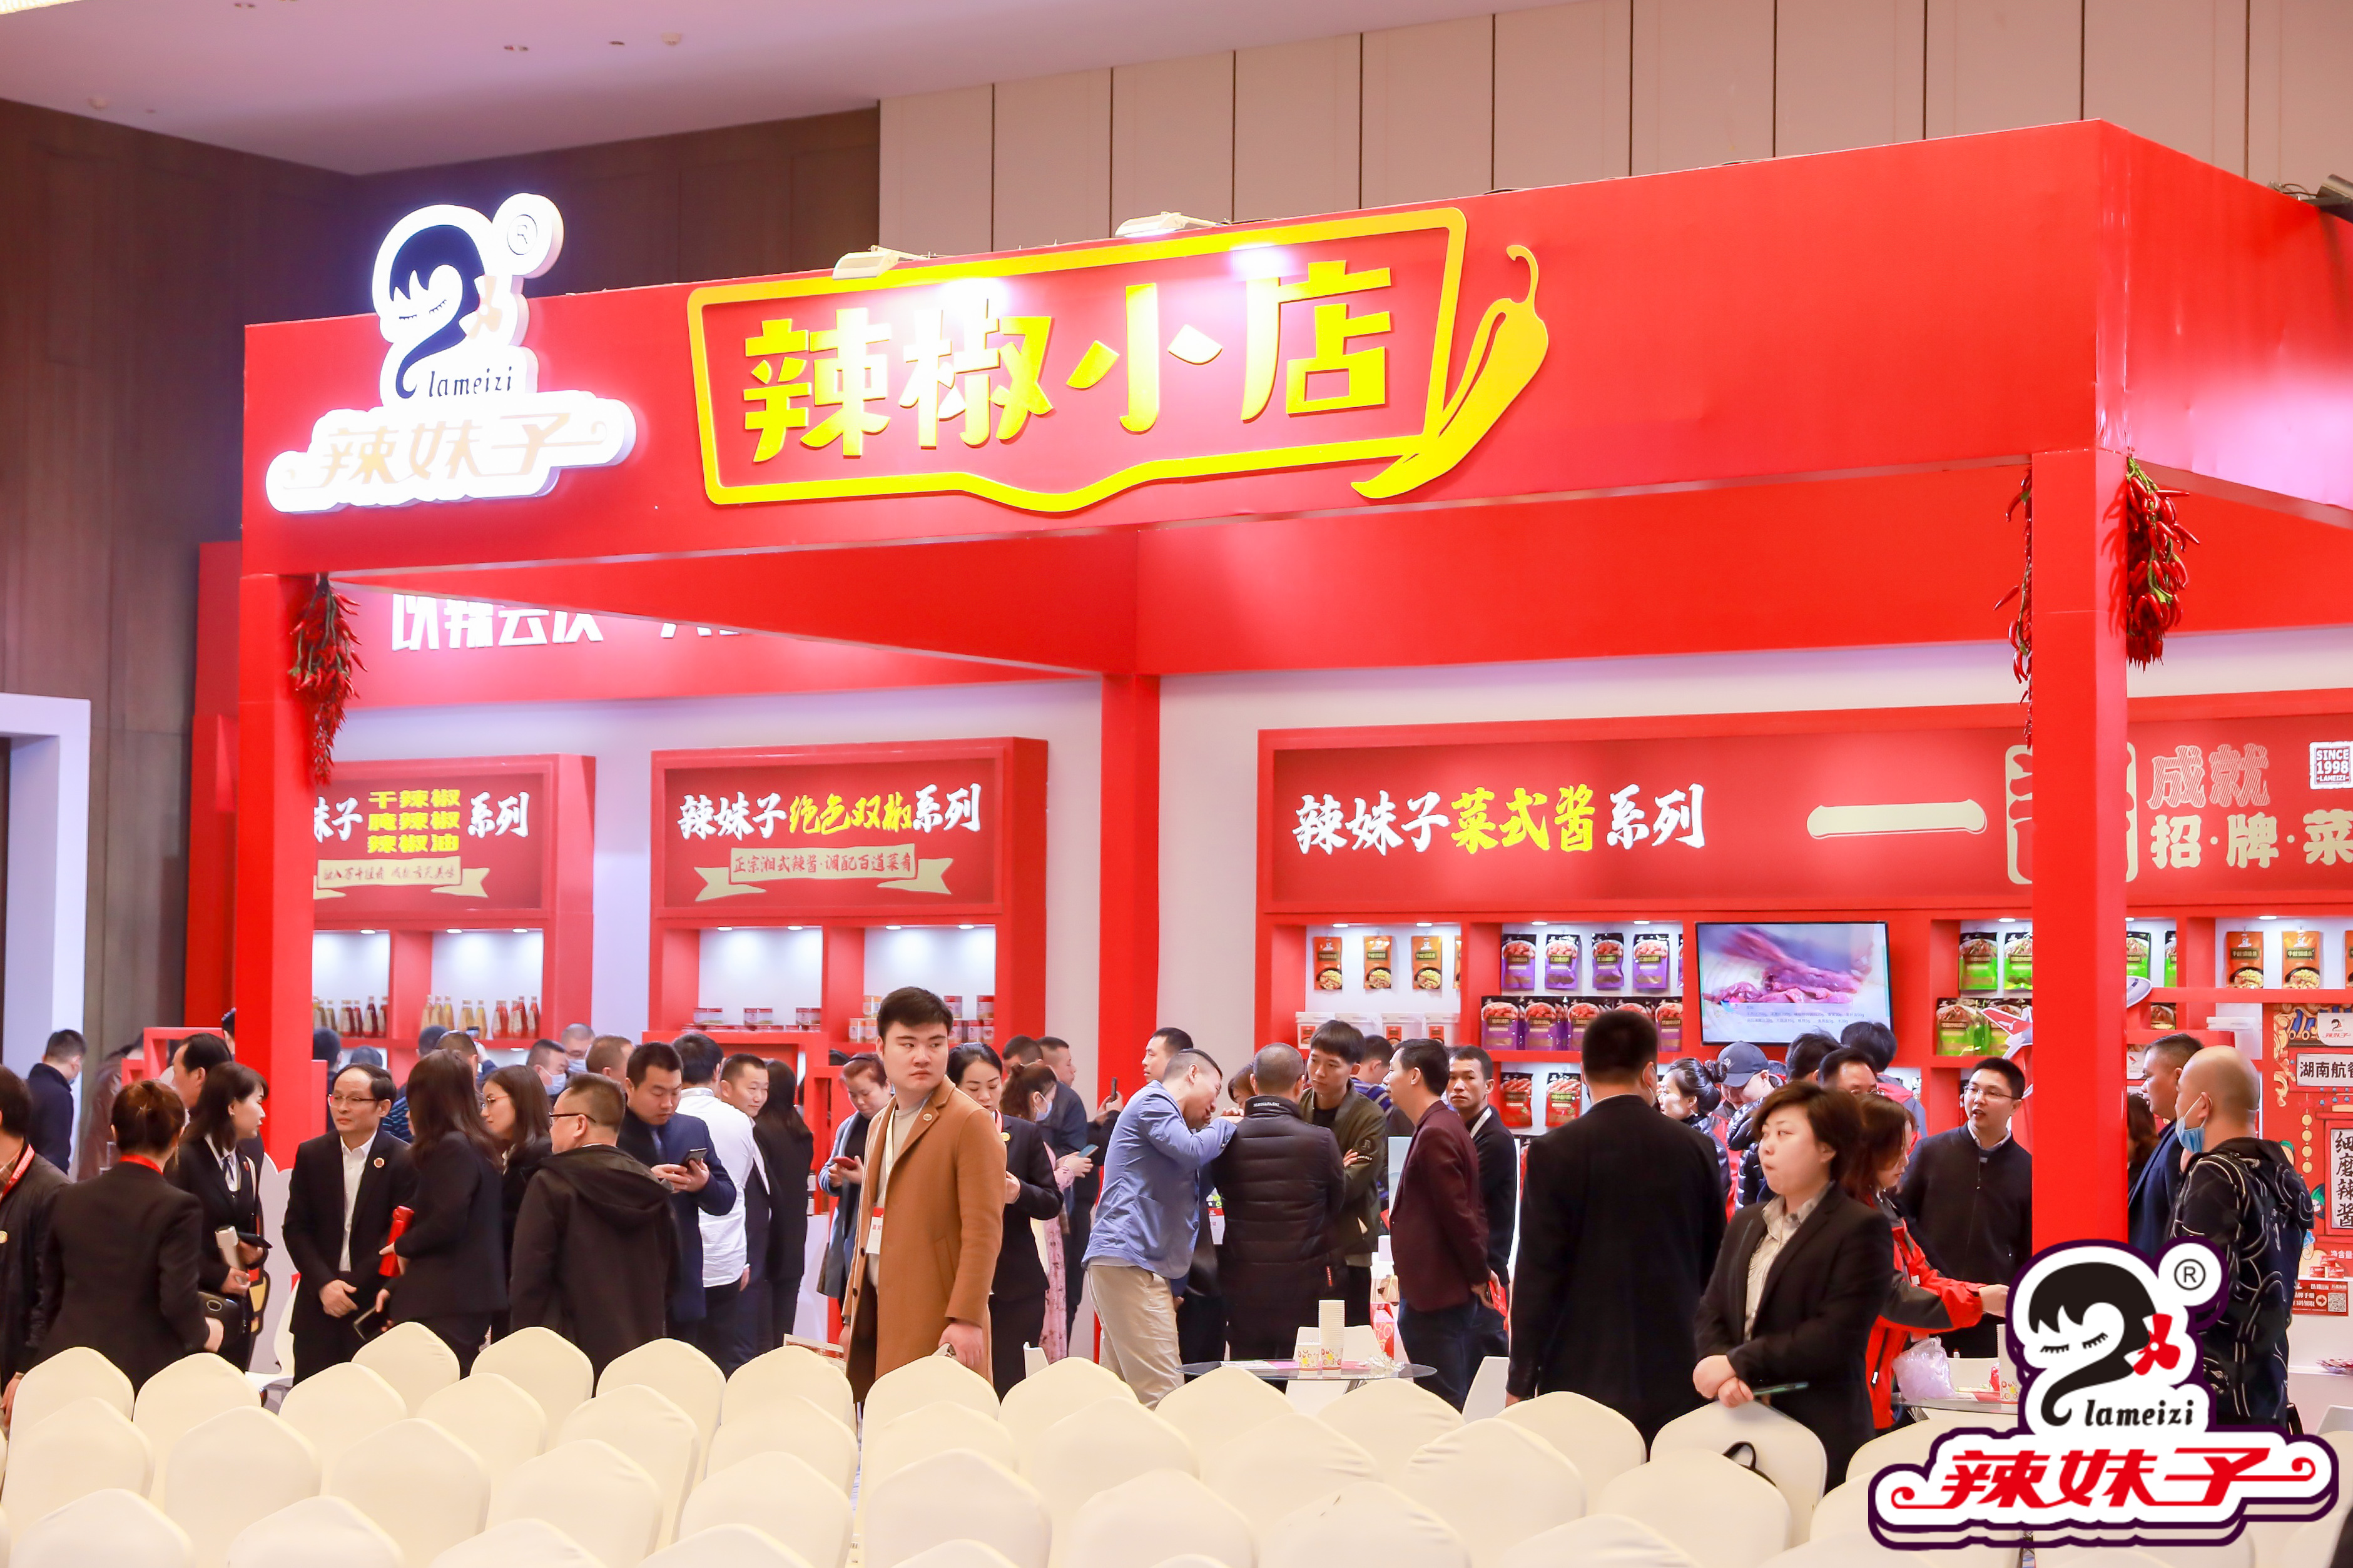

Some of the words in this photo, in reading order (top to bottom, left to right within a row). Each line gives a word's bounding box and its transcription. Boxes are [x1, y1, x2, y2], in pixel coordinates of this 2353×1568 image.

[745, 260, 1391, 463] 辣椒小店
[428, 366, 513, 399] lameizi
[284, 412, 607, 490] 辣妹子
[2316, 749, 2349, 761] SINCE
[2316, 761, 2349, 774] 1998
[2147, 743, 2270, 809] 成就
[368, 789, 461, 809] 干辣椒
[367, 811, 460, 831] 腌辣椒
[467, 791, 530, 839] 系列
[367, 833, 460, 853] 辣椒油
